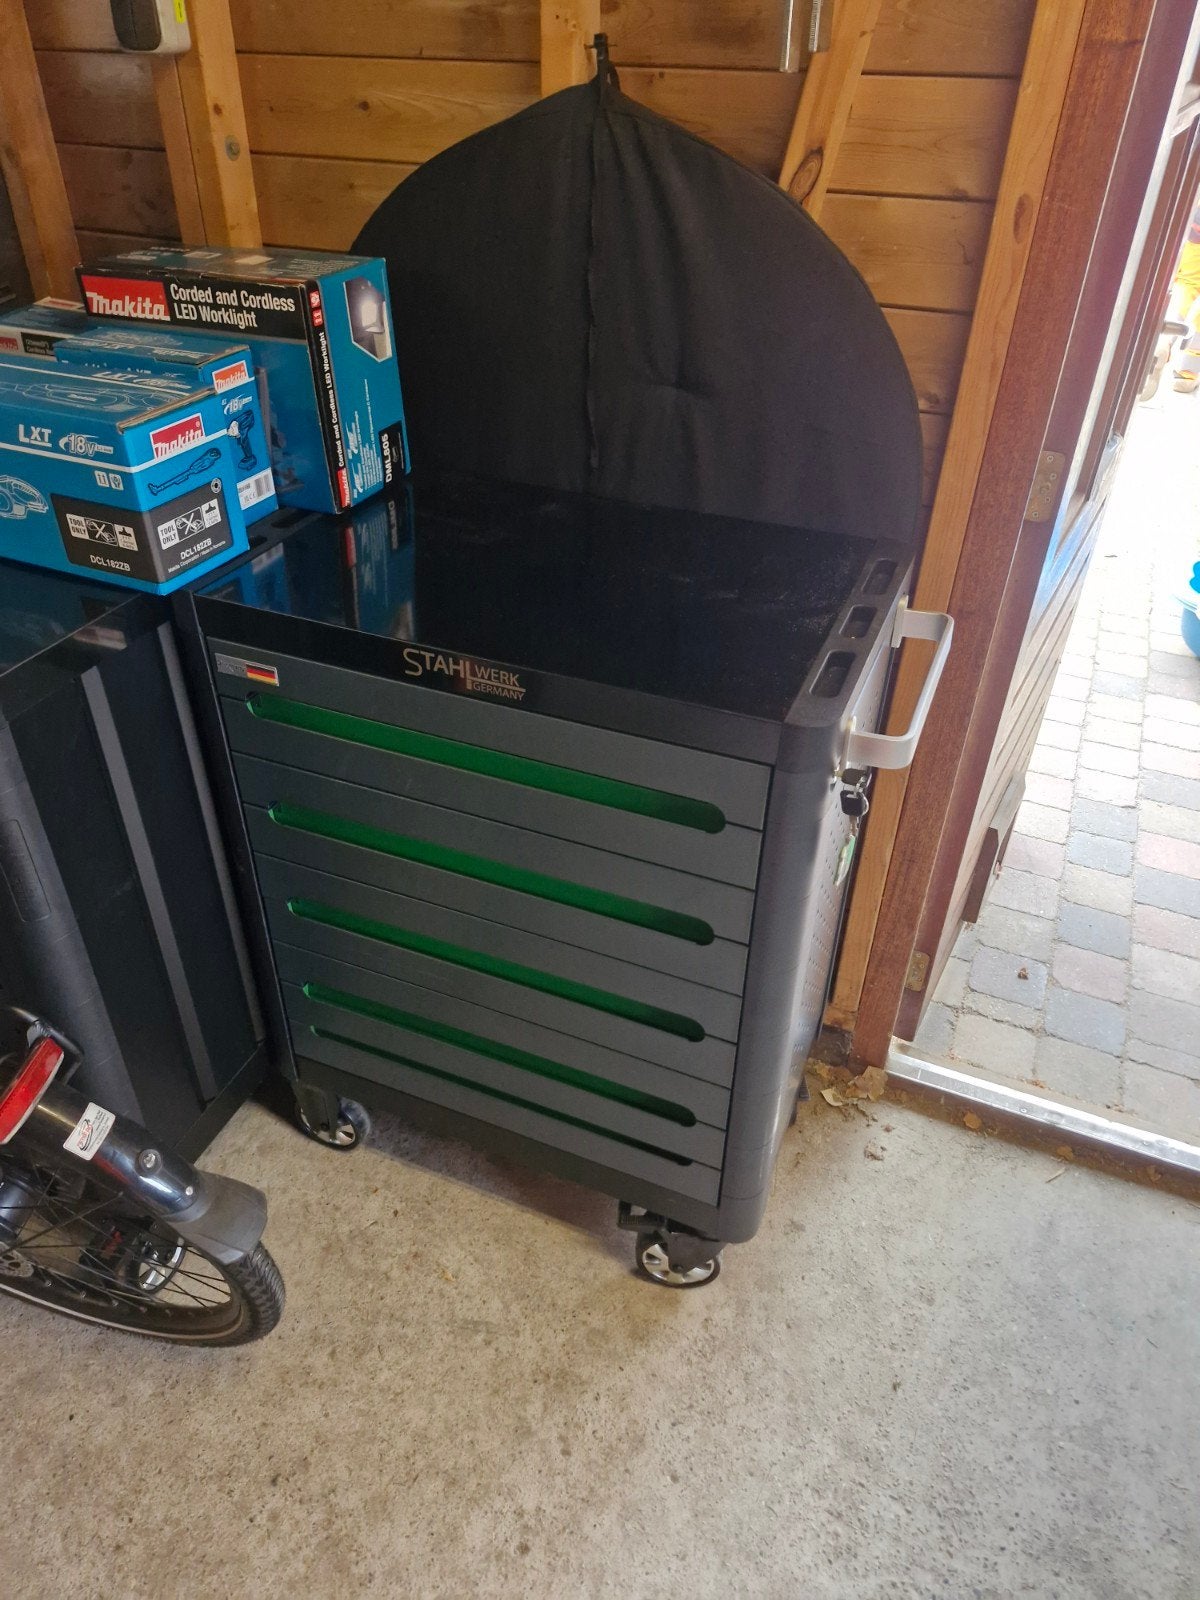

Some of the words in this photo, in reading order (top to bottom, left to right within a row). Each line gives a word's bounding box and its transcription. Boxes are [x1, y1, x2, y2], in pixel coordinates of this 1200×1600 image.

[170, 284, 214, 304] Corded
[216, 289, 238, 306] and
[240, 292, 296, 312] Cordless
[173, 302, 197, 320] LED
[198, 307, 258, 330] Worklight
[319, 332, 330, 372] Worklight
[329, 389, 338, 424] Cordless
[18, 423, 52, 445] LXT
[336, 440, 345, 467] Corded
[382, 433, 393, 483] DML805
[69, 518, 85, 527] TOOL
[71, 526, 86, 535] ONLY
[160, 525, 175, 536] TOOL
[162, 533, 177, 544] ONLY
[180, 538, 212, 560] DCL182ZB
[90, 555, 131, 571] DCL182ZB
[473, 682, 525, 701] GERMANY
